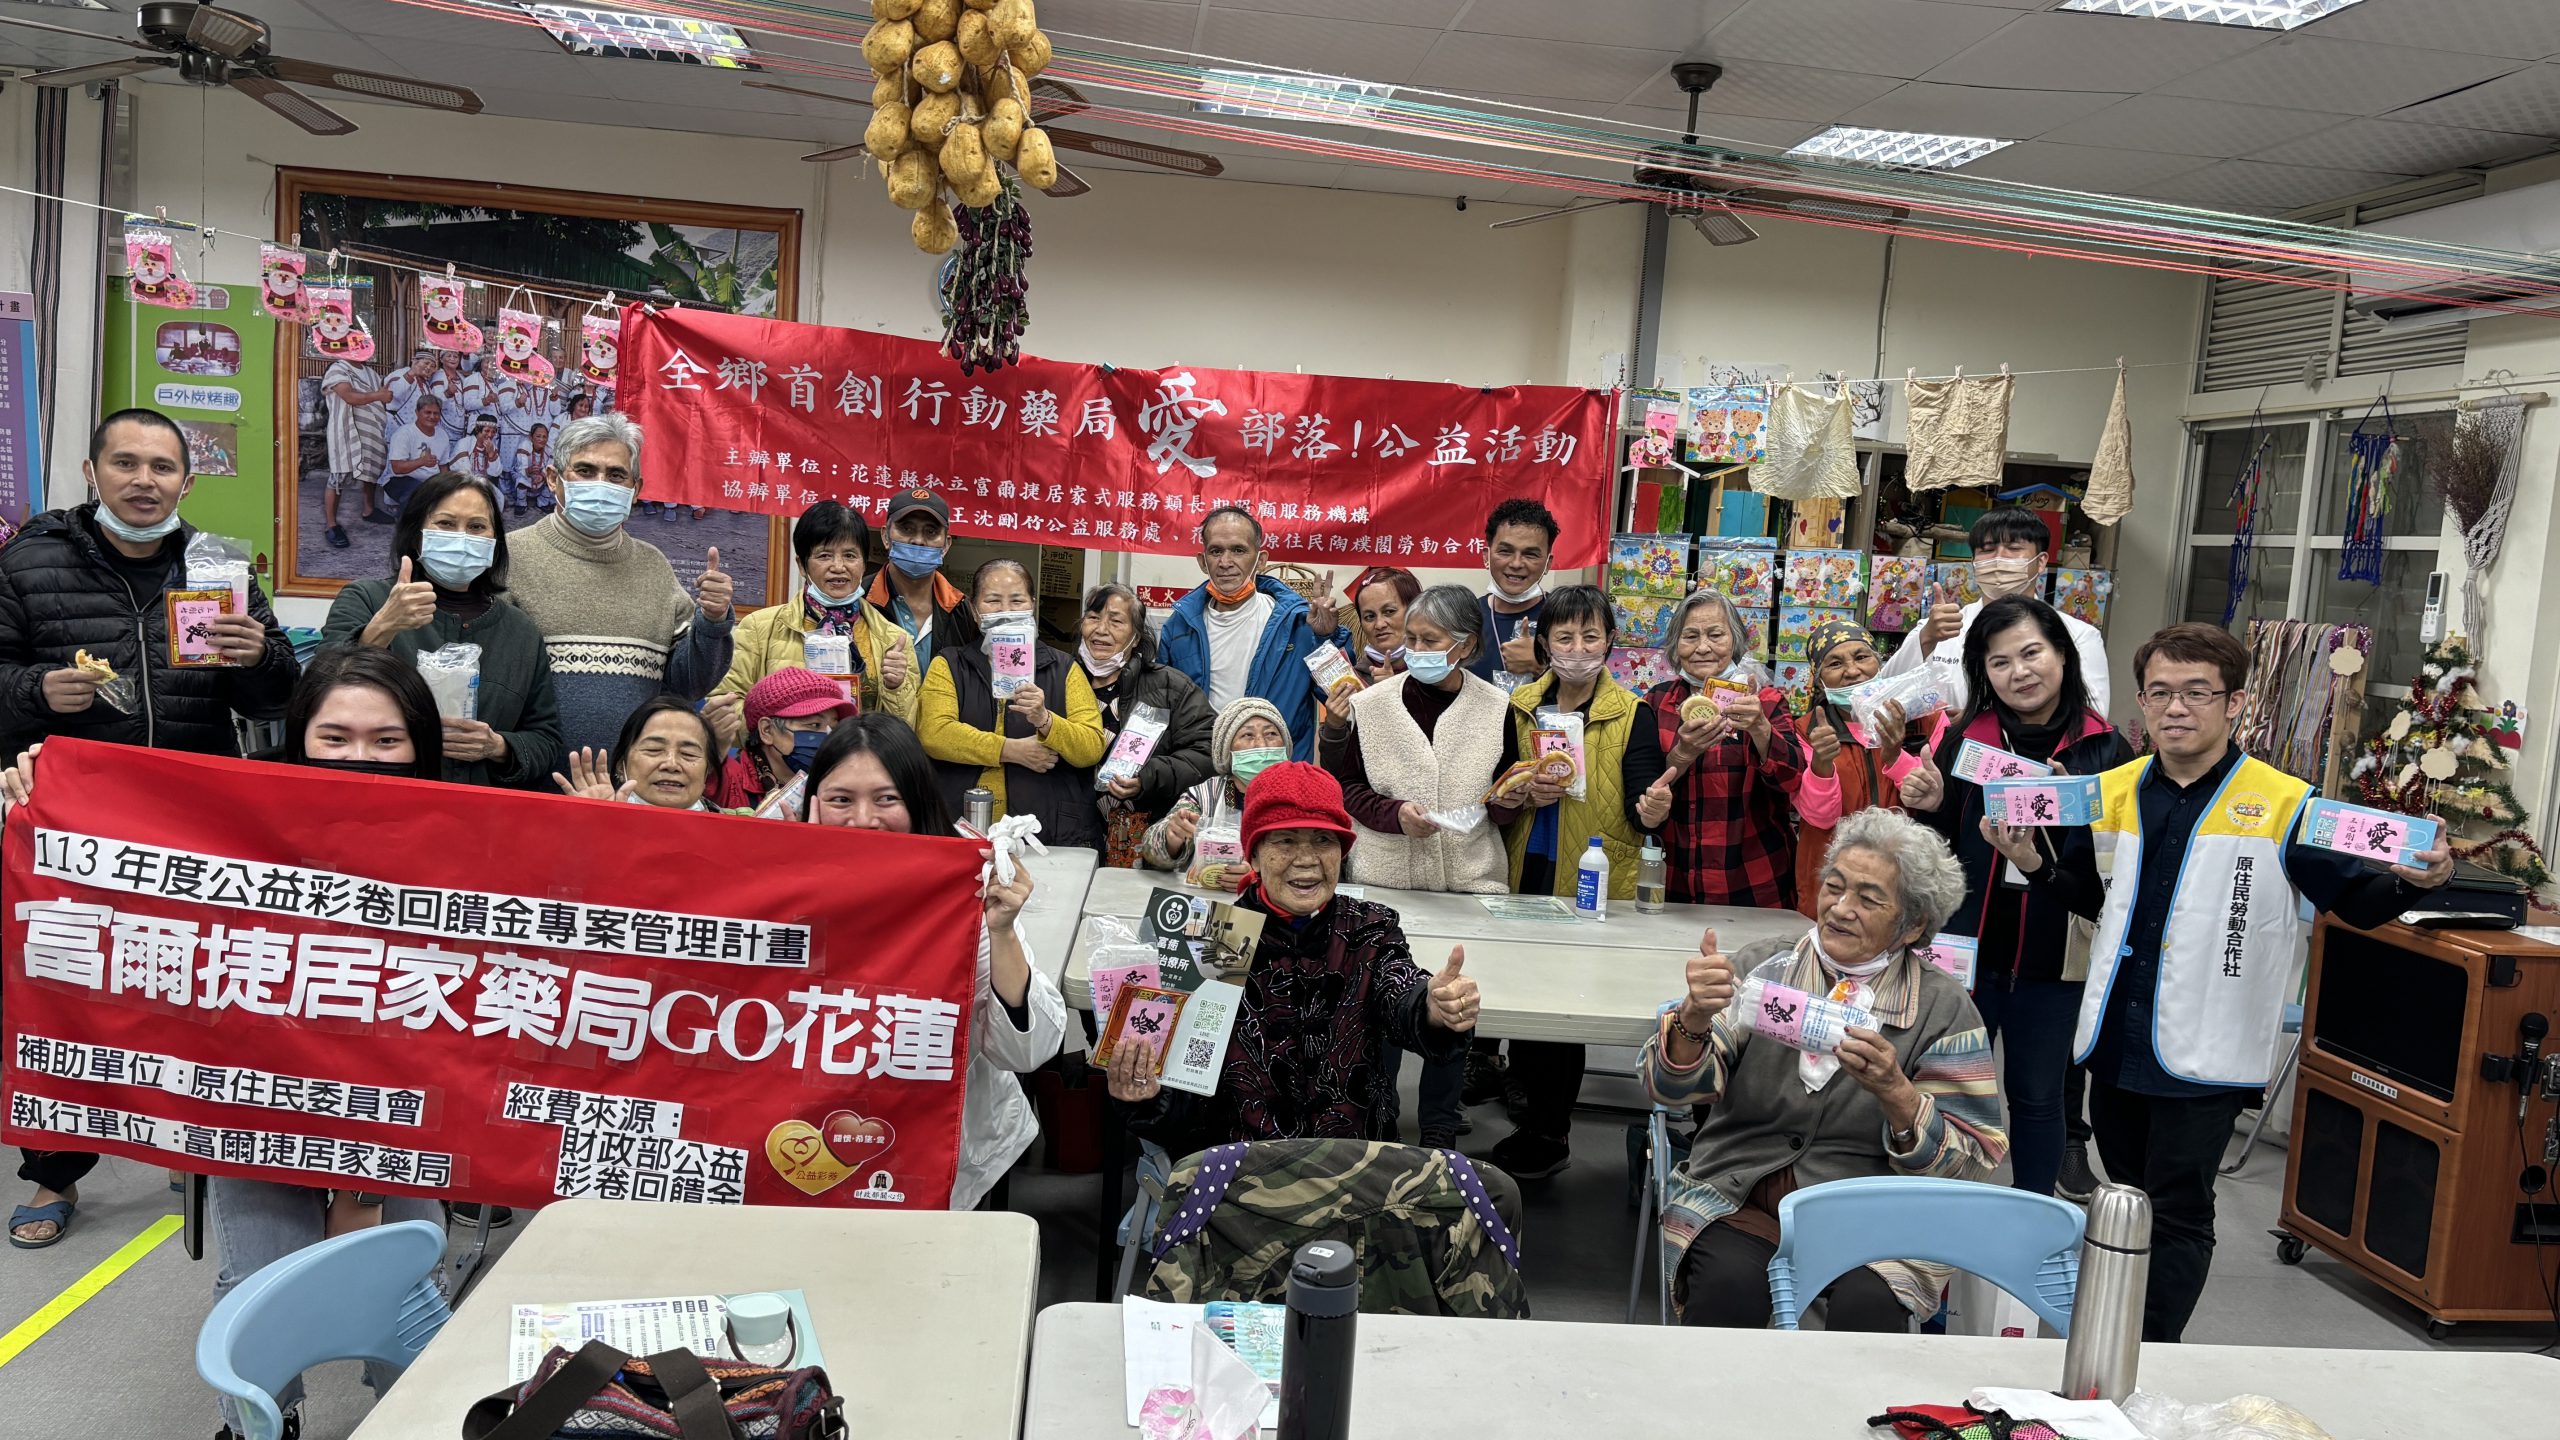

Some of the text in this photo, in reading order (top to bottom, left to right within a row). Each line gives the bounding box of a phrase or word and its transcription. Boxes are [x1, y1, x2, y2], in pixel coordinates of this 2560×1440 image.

[1139, 587, 1191, 604] 滅火
[2030, 793, 2054, 821] 愛
[36, 832, 99, 876] 113
[2366, 821, 2398, 854] 愛
[2222, 855, 2255, 978] 原住民勞動合作社
[15, 896, 960, 1081] 富爾捷居家藥局GO花蓮
[1763, 996, 1797, 1024] 愛
[1130, 1007, 1166, 1035] 愛
[17, 1034, 424, 1126] 補助單位：原住民委員會
[508, 1083, 682, 1134] 經費來源：
[11, 1093, 451, 1188] 執行單位：富爾捷居家藥局
[560, 1126, 743, 1184] 財政部公益
[795, 1169, 839, 1182] 公益彩券
